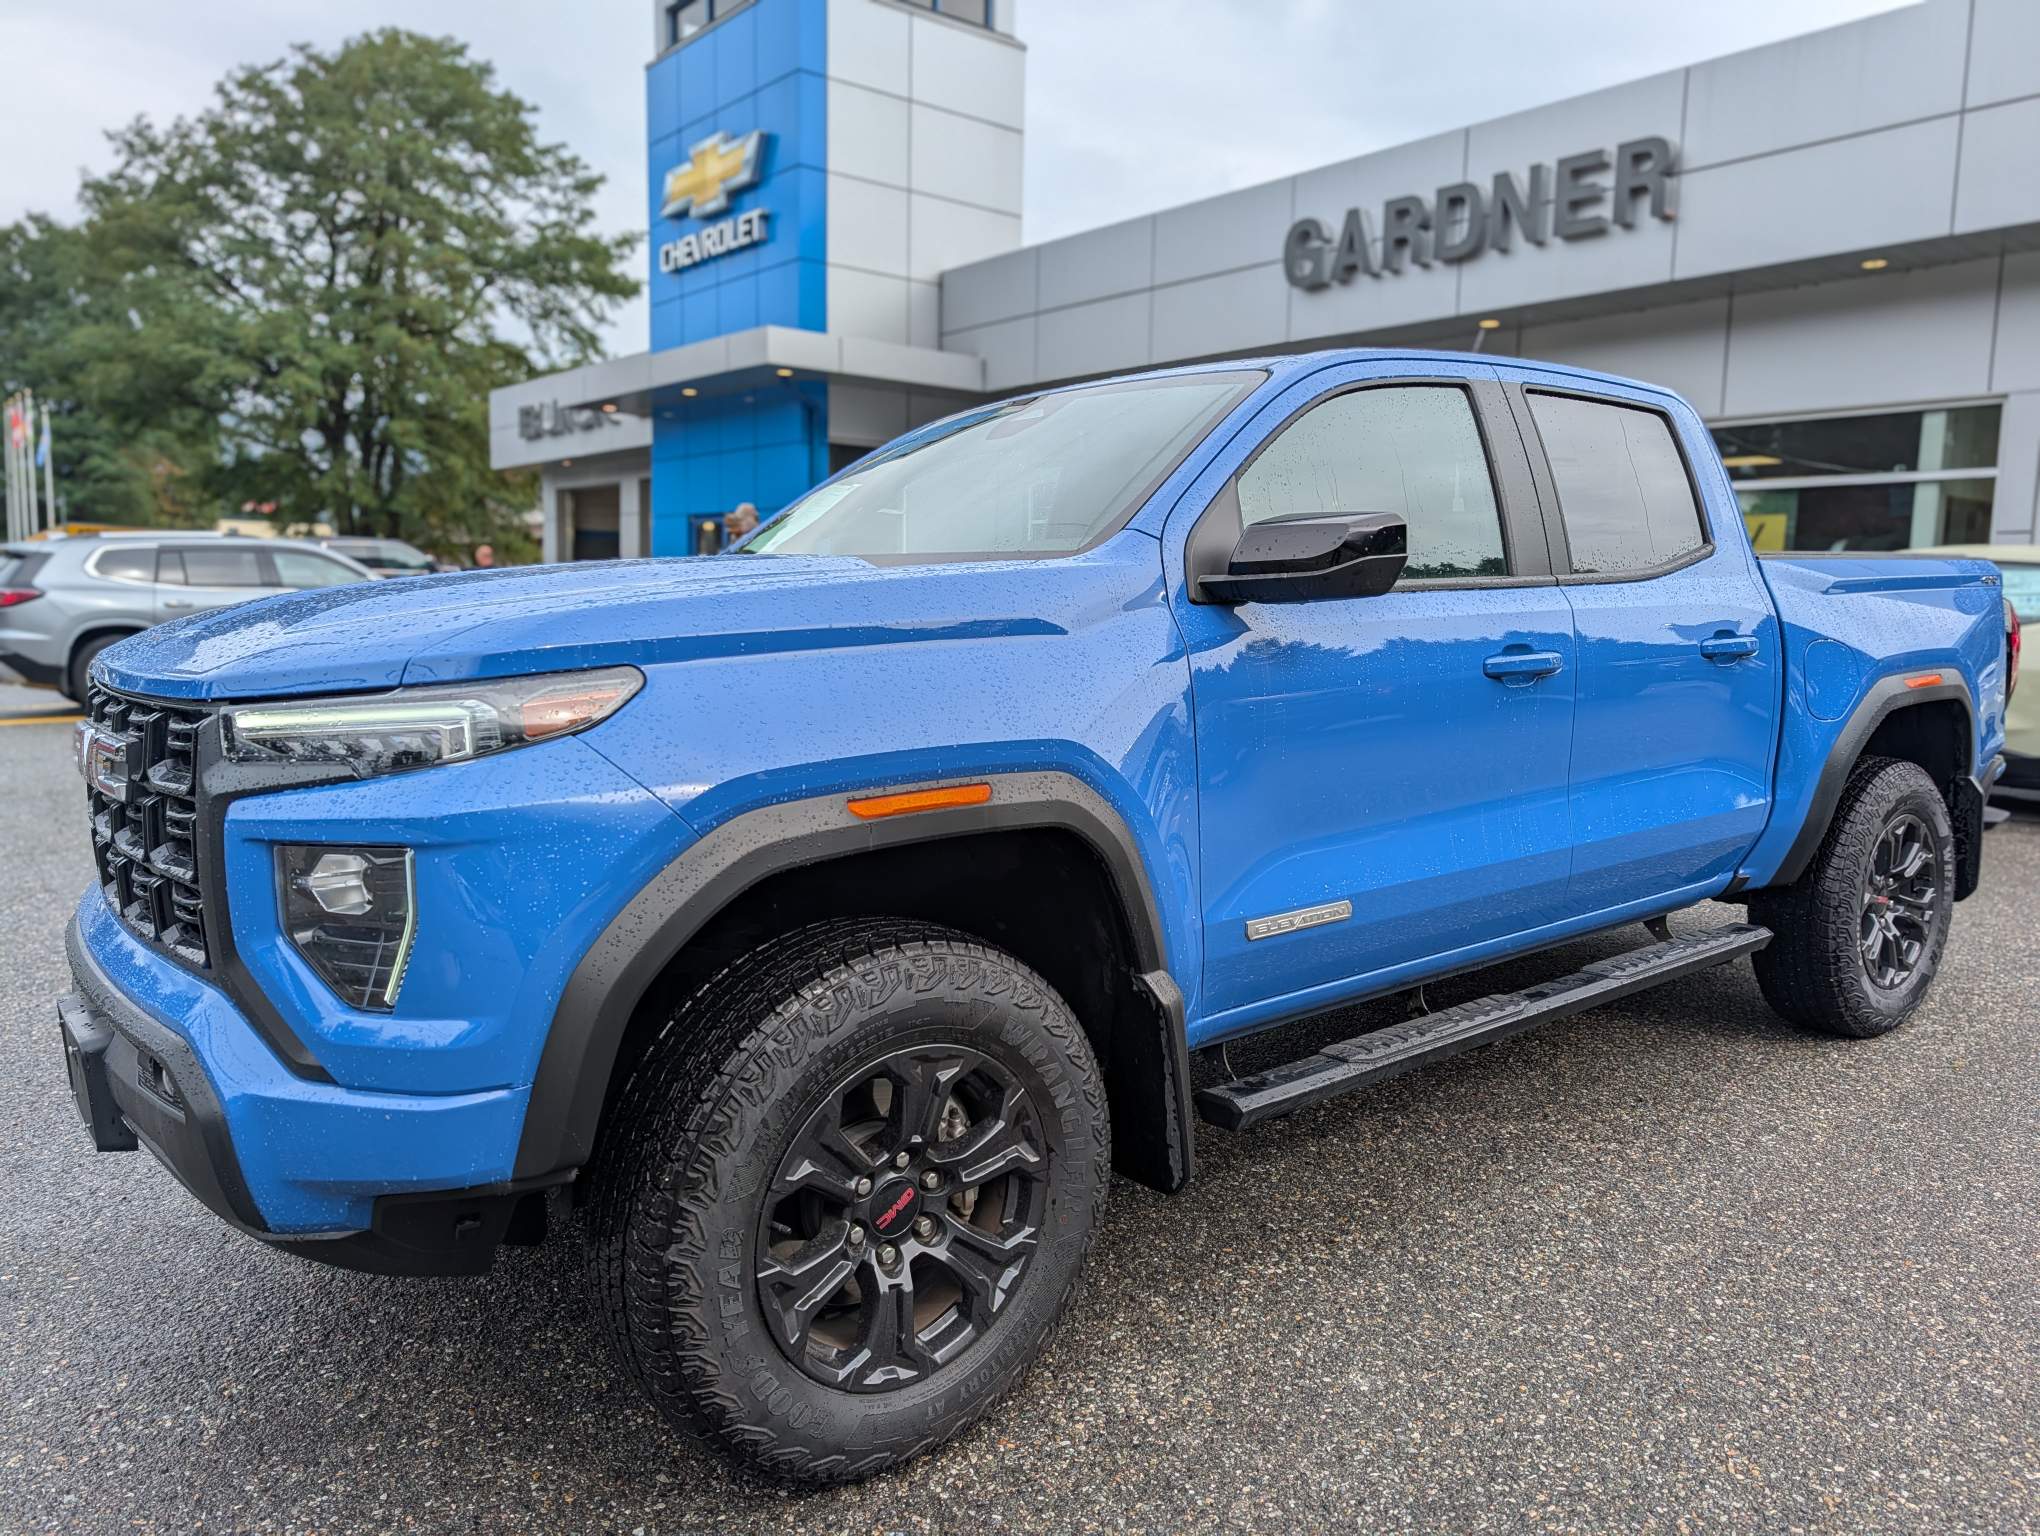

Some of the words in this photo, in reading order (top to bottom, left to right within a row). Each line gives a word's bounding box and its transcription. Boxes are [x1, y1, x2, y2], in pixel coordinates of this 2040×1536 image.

[659, 207, 769, 273] CHEVROLET
[1283, 136, 1677, 293] GARDNER
[1255, 906, 1346, 934] ELEVATION
[1001, 1015, 1089, 1217] WRANGLER
[875, 1186, 915, 1230] GMC
